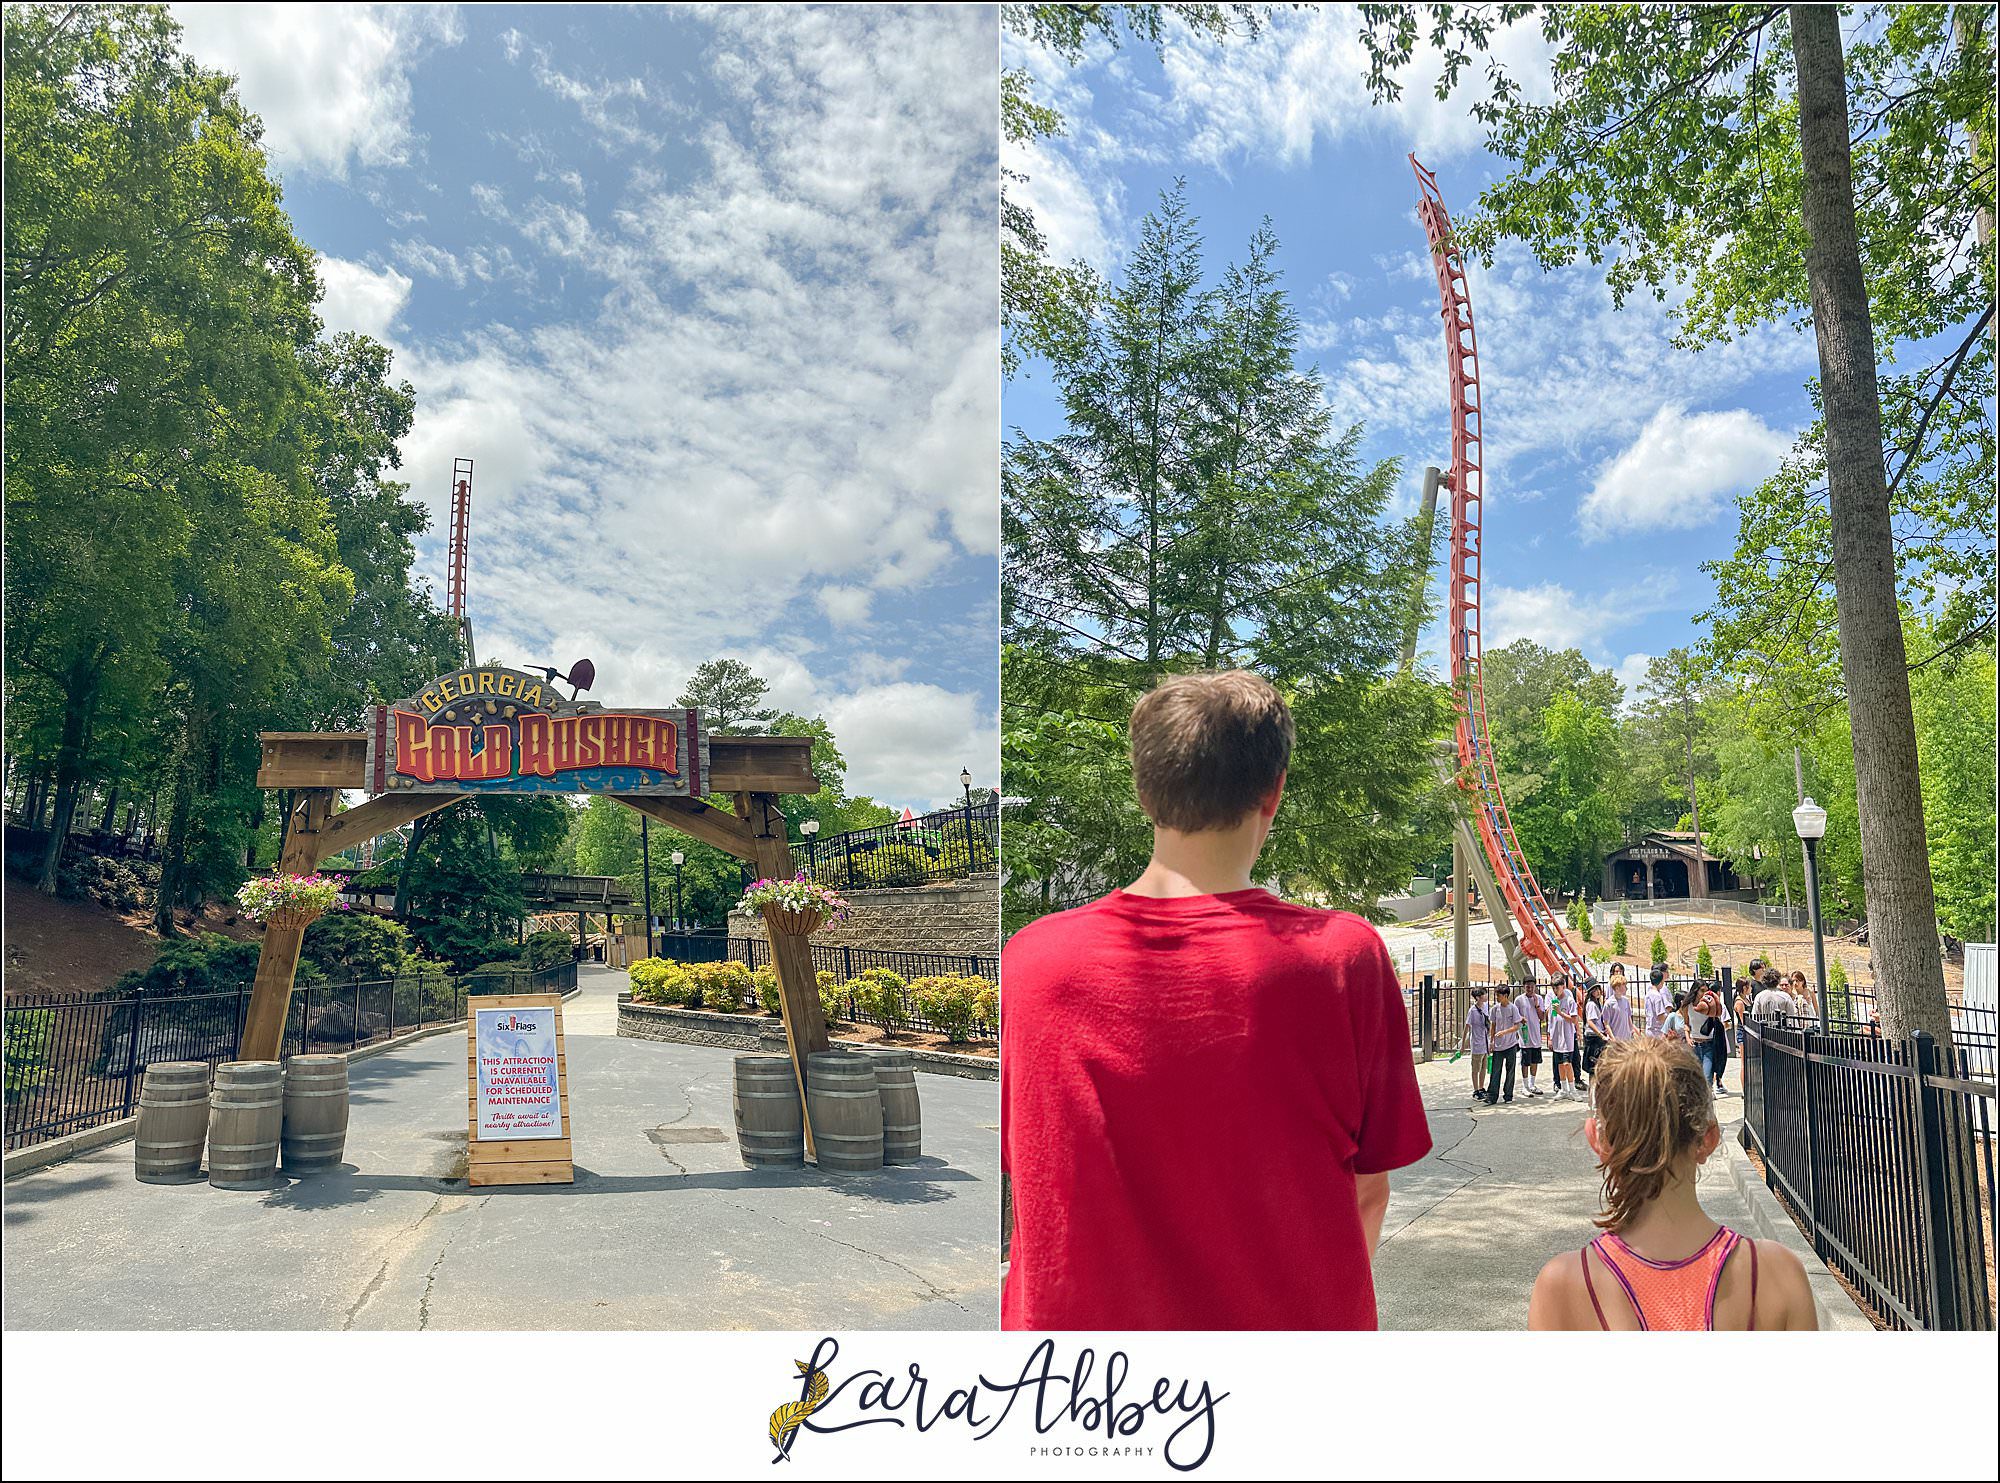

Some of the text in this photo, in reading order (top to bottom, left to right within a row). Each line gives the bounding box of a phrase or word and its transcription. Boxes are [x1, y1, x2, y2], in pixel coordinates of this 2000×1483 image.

[422, 672, 543, 713] GEORGIA
[394, 709, 680, 783] GOLD RUSHER
[497, 1022, 537, 1032] Six Flags
[482, 1056, 554, 1066] THIS ATTRACTION
[500, 1066, 546, 1075] CURRENTLY
[490, 1076, 547, 1085] UNAVAILABLE
[485, 1086, 553, 1095] FOR SCHEDULED
[488, 1096, 551, 1105] MAINTENANCE
[517, 1112, 540, 1120] await
[484, 1122, 511, 1130] nearby
